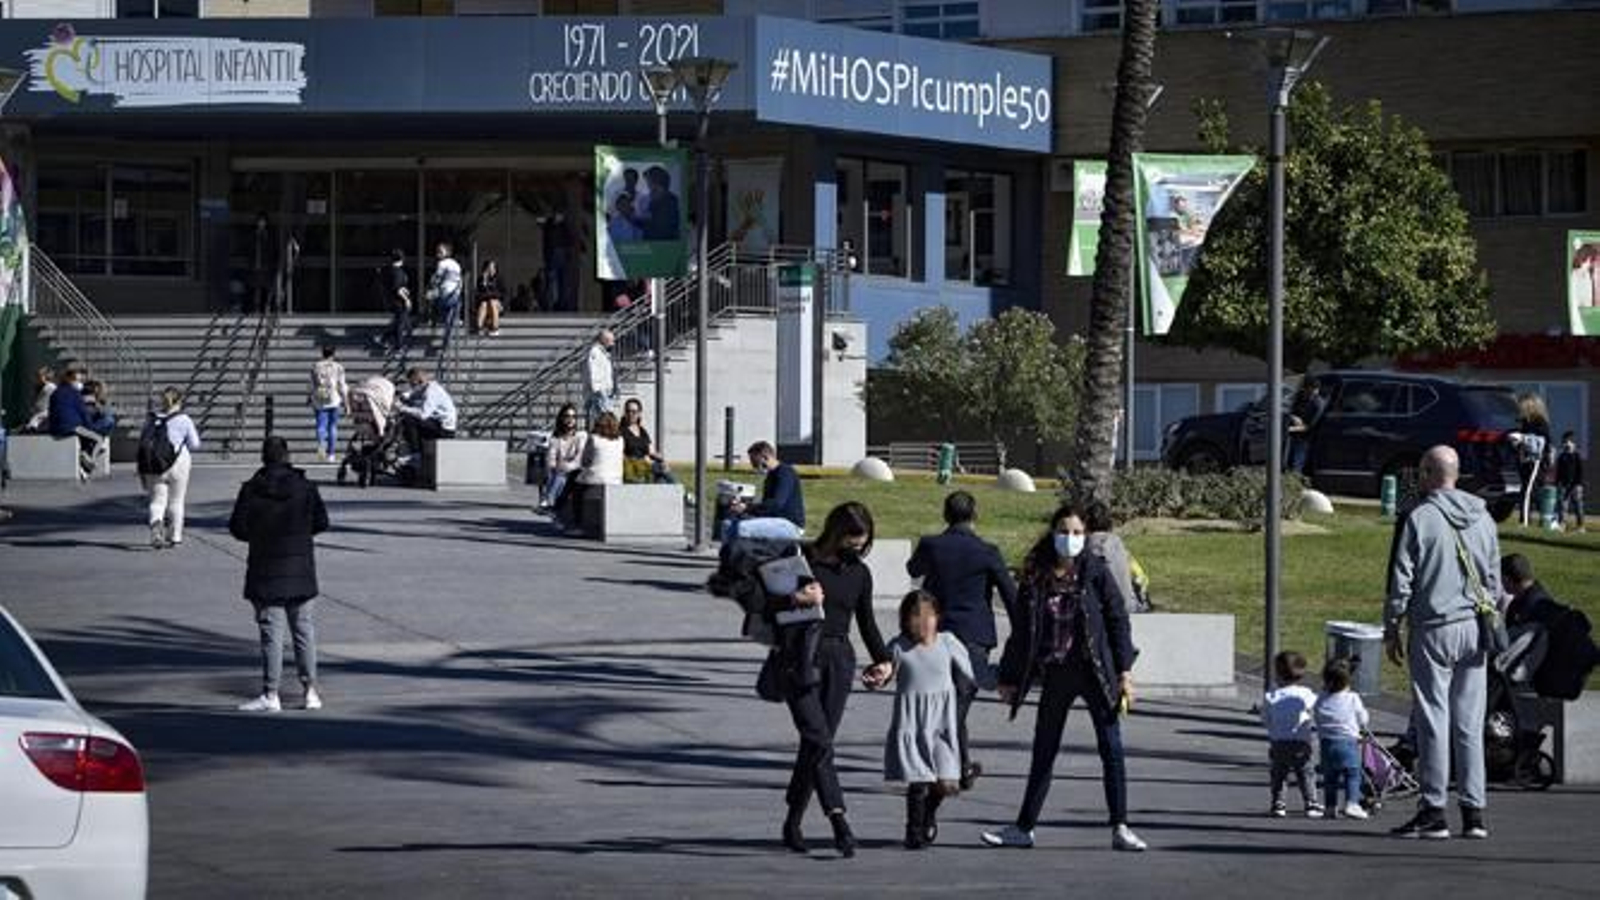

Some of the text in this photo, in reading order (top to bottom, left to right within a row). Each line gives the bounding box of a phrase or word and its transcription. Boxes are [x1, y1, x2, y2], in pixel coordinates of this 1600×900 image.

[564, 23, 606, 67] 1971
[638, 23, 699, 65] 2021
[114, 48, 299, 83] HOSPITAL INFANTIL
[529, 71, 632, 103] CRECIENDO
[770, 47, 1050, 130] #MiHOSPIcumple50
